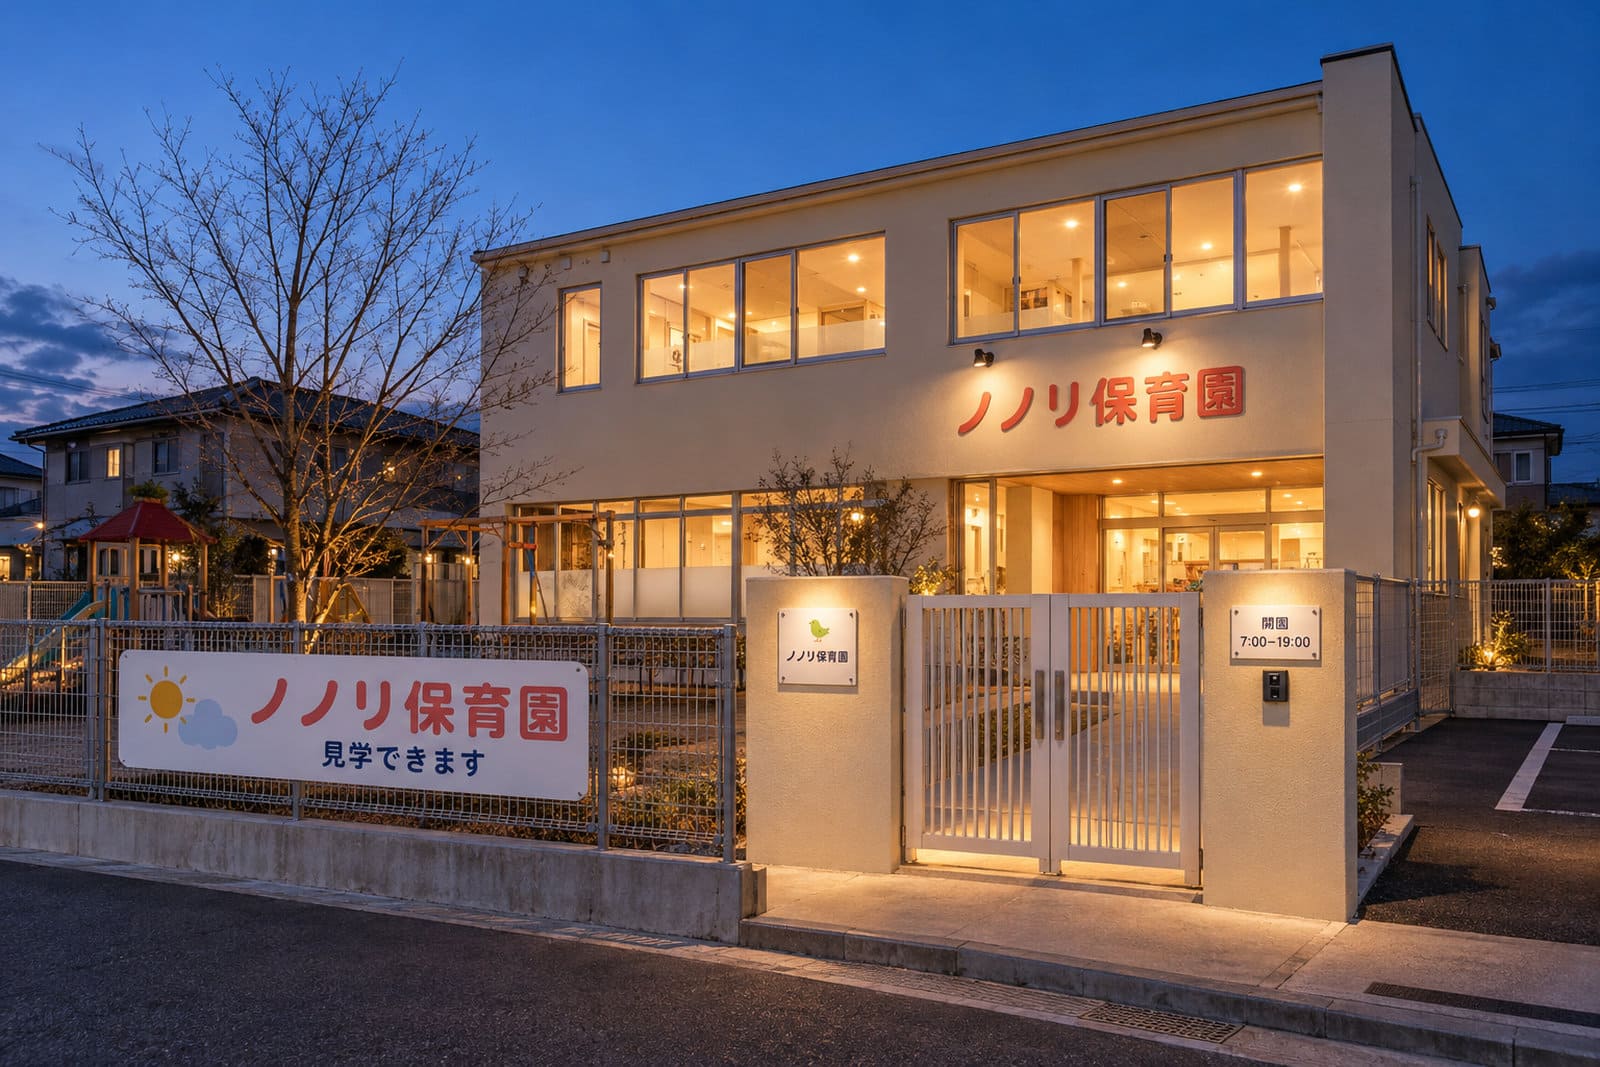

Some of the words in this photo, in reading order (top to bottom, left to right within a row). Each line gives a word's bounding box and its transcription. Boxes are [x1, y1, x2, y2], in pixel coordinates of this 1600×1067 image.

[958, 366, 1243, 434] ノノリ保育園
[786, 650, 849, 664] ノノリ保育園
[251, 678, 568, 742] ノノリ保育園
[323, 741, 484, 777] 見学できます
